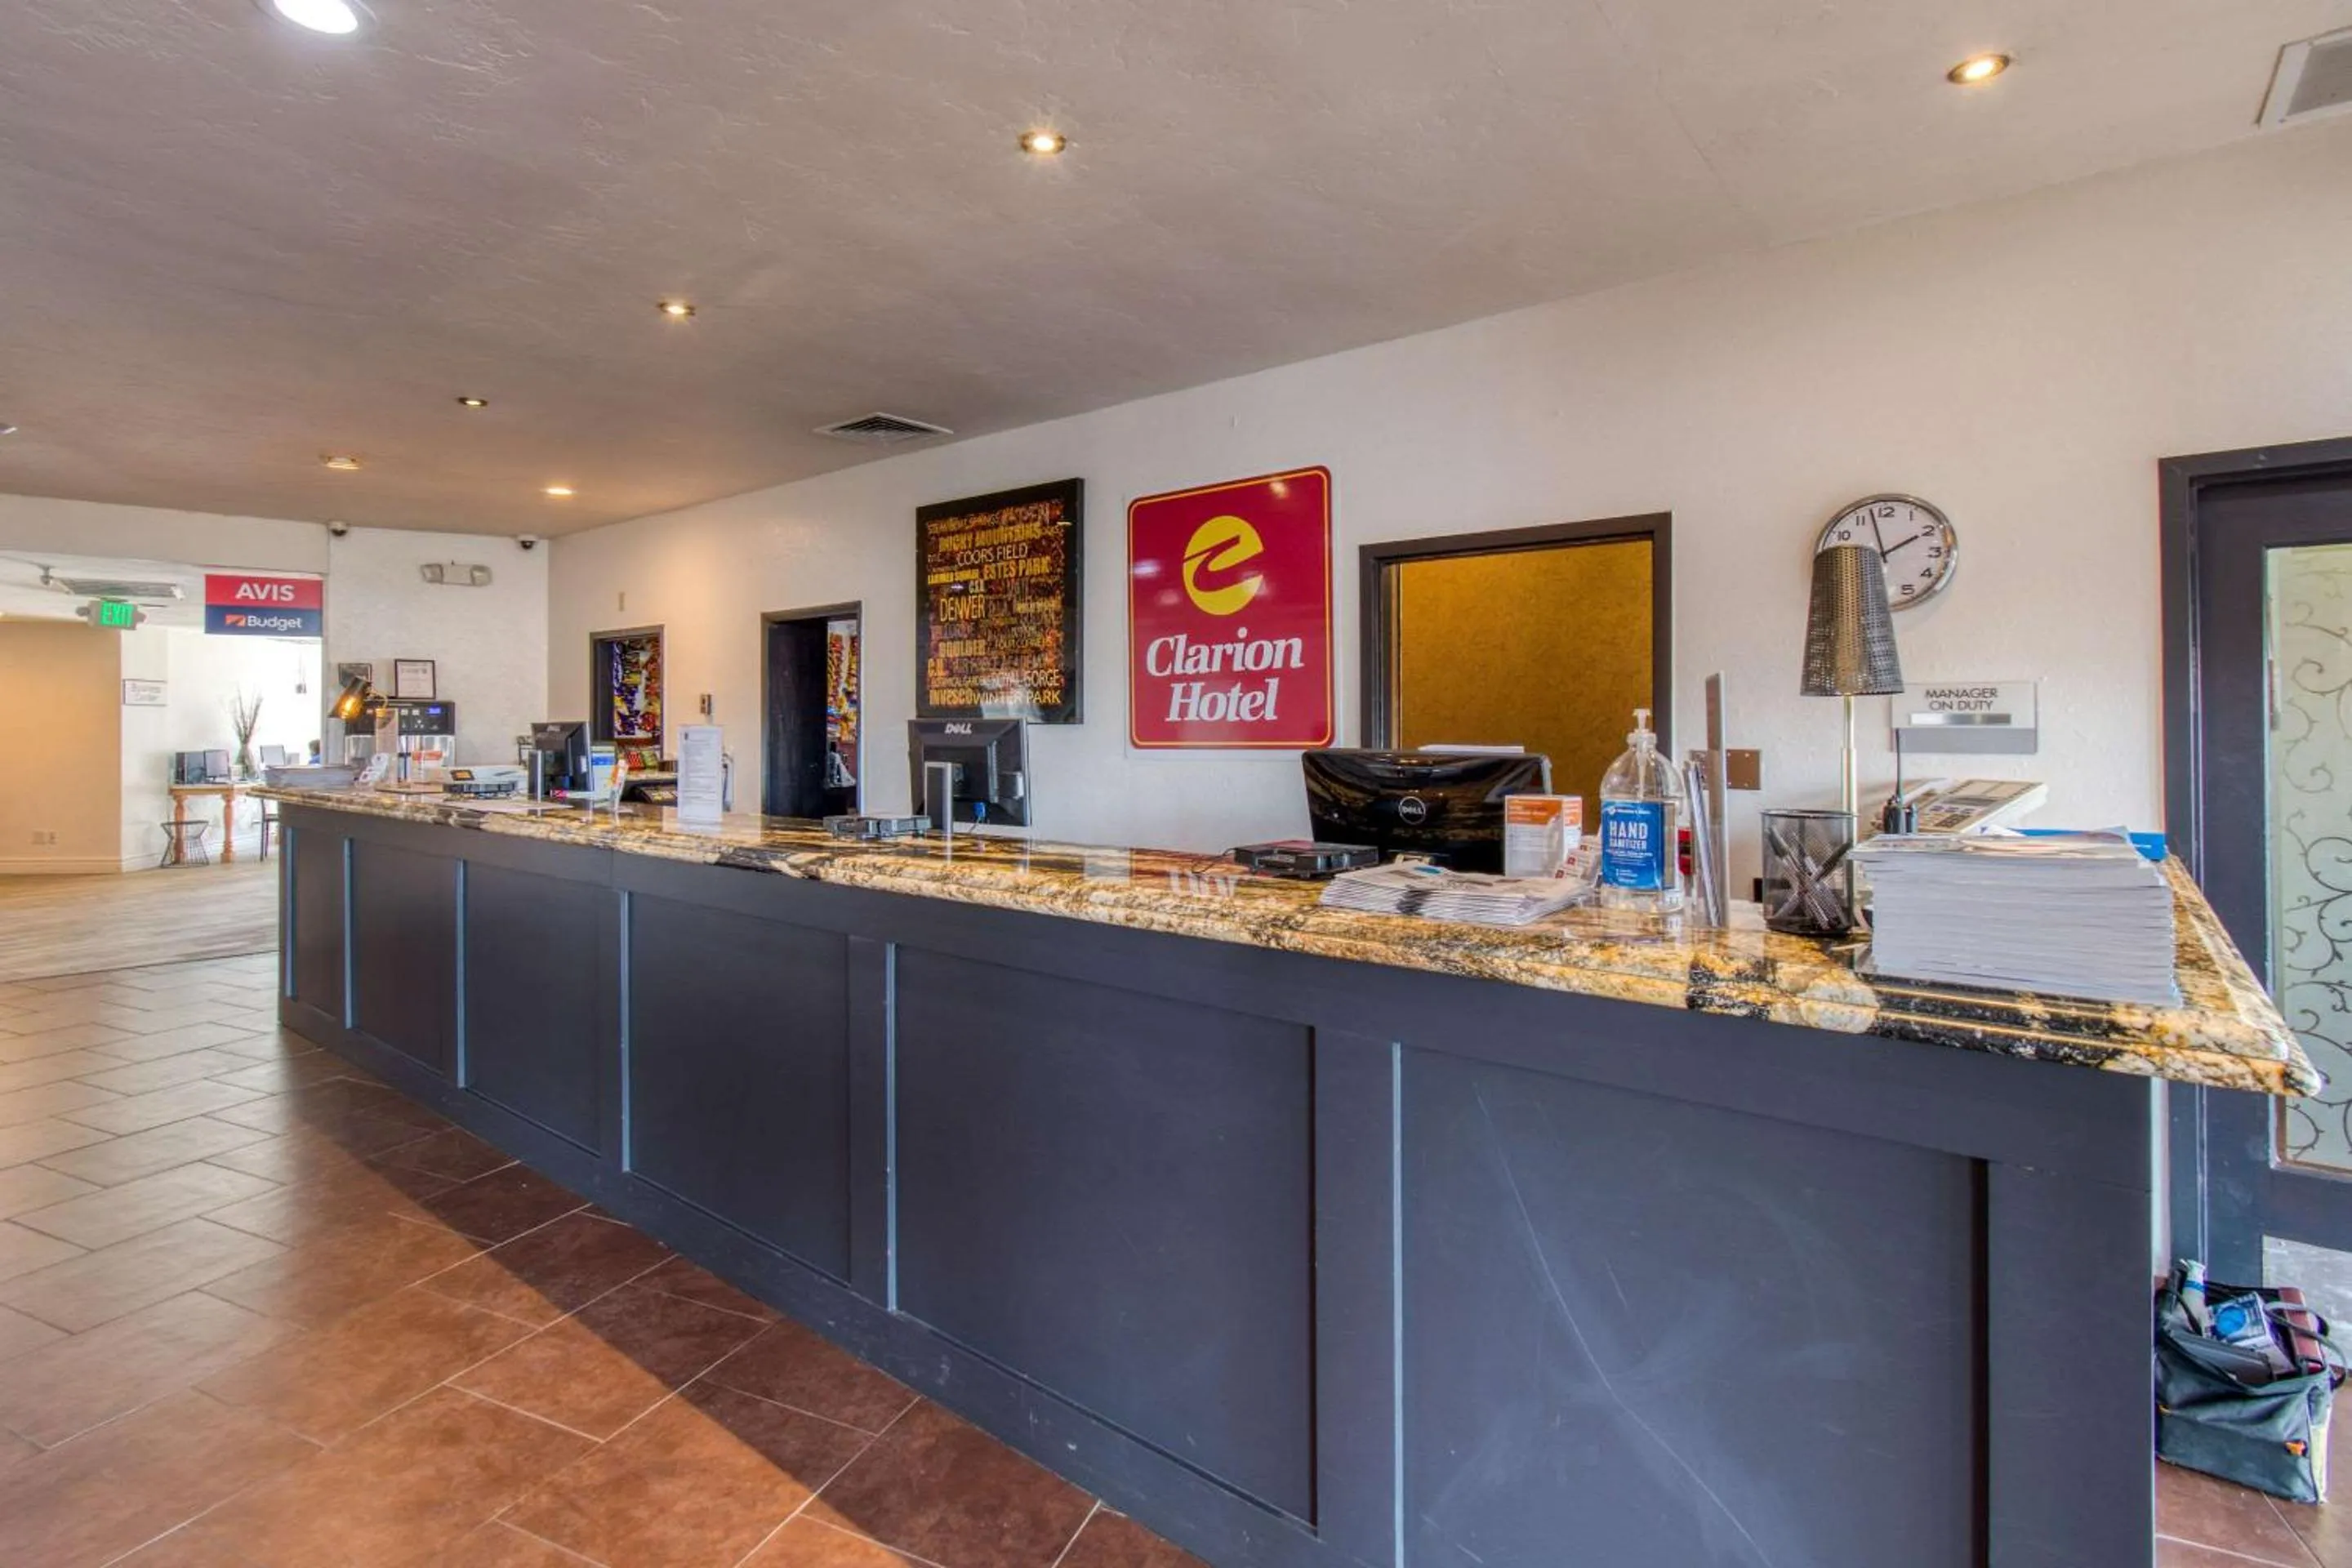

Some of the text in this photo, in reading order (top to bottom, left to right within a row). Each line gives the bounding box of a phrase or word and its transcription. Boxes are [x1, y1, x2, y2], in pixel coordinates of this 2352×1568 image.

[1878, 506, 1895, 518] 12
[1909, 510, 1913, 521] 1
[1856, 515, 1865, 525] 11
[1838, 531, 1851, 541] 10
[1921, 525, 1935, 537] 2
[956, 547, 994, 567] COORS
[996, 542, 1028, 561] FIELD
[1928, 546, 1941, 558] 3
[983, 561, 1017, 581] ESTES
[1018, 555, 1051, 577] PARK
[1921, 568, 1932, 577] 4
[235, 583, 295, 602] AVIS
[1901, 584, 1914, 595] 5
[100, 600, 135, 627] EXIT
[940, 595, 986, 622] DENVER
[247, 615, 302, 630] Budget
[1146, 626, 1305, 677] Clarion
[1025, 669, 1059, 688] GORGE
[1027, 689, 1061, 705] PARK
[1165, 677, 1280, 722] Hotel
[1925, 688, 1998, 699] MANAGER
[1929, 700, 1993, 710] ON DUTY
[1401, 805, 1423, 814] DELL
[1609, 820, 1648, 840] HAND
